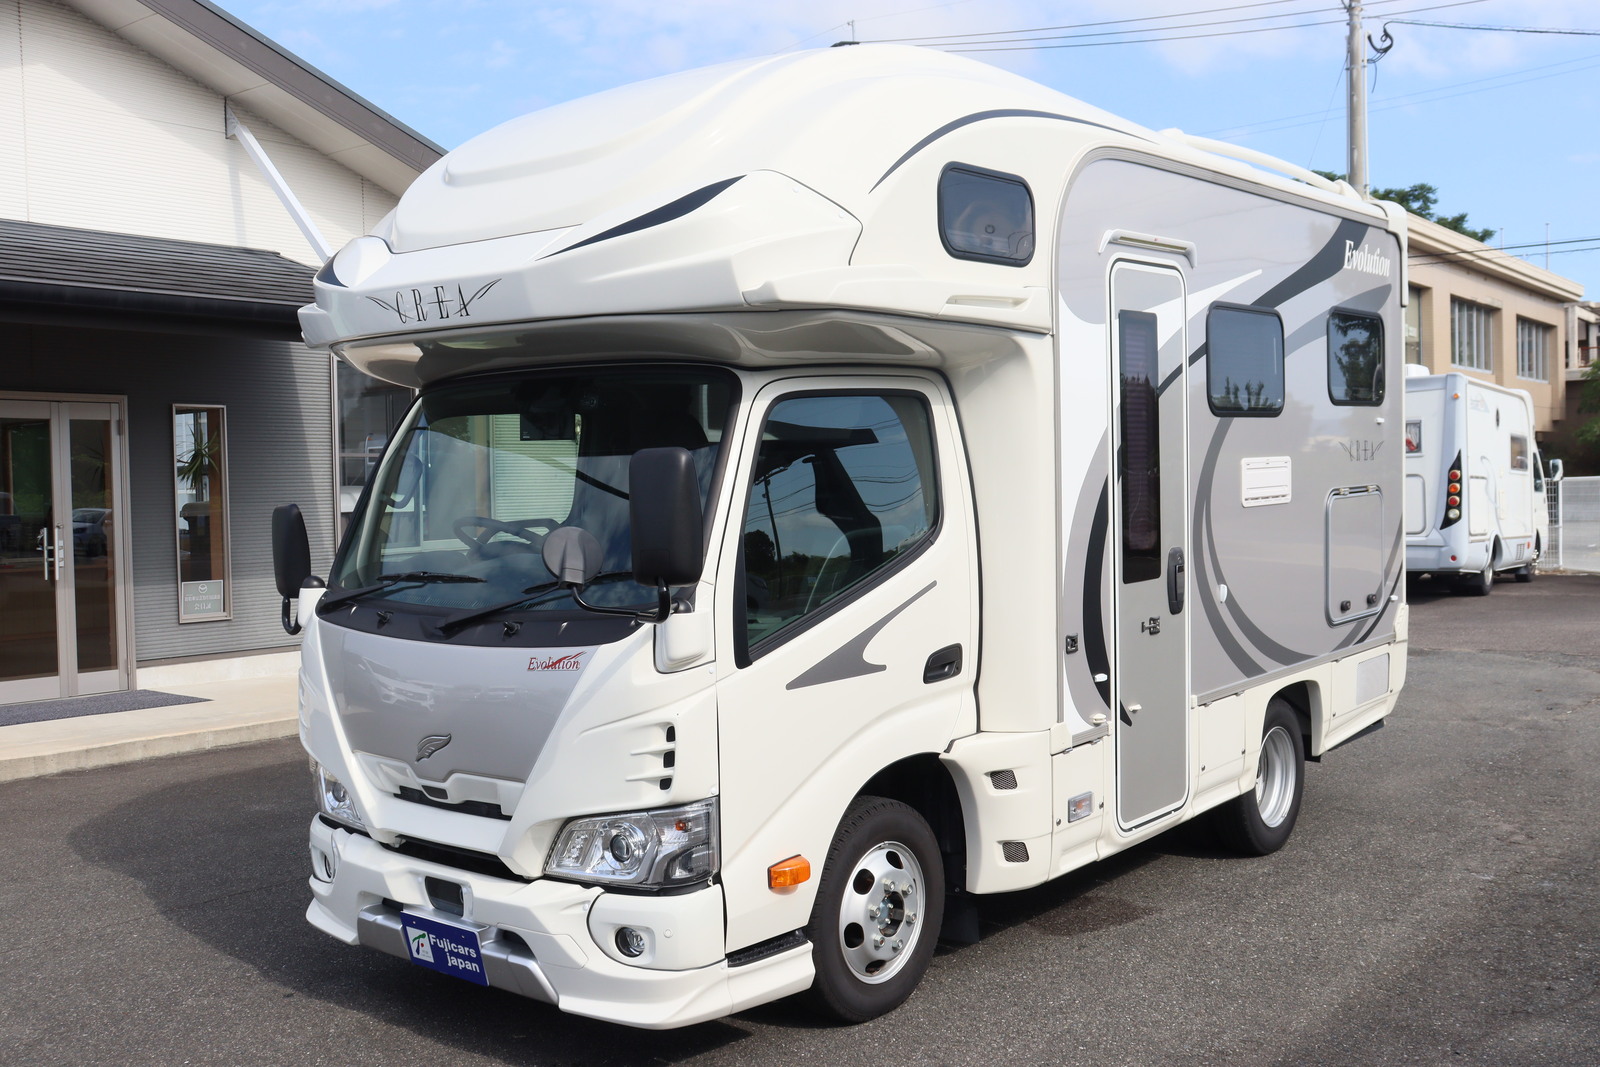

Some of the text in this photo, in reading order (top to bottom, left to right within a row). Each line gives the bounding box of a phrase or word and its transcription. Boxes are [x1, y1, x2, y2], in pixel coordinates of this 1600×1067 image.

[1343, 239, 1390, 278] Evolution
[390, 281, 476, 325] CREA
[527, 655, 580, 671] Evolution
[428, 933, 477, 958] Fujicars
[446, 952, 480, 973] japan
